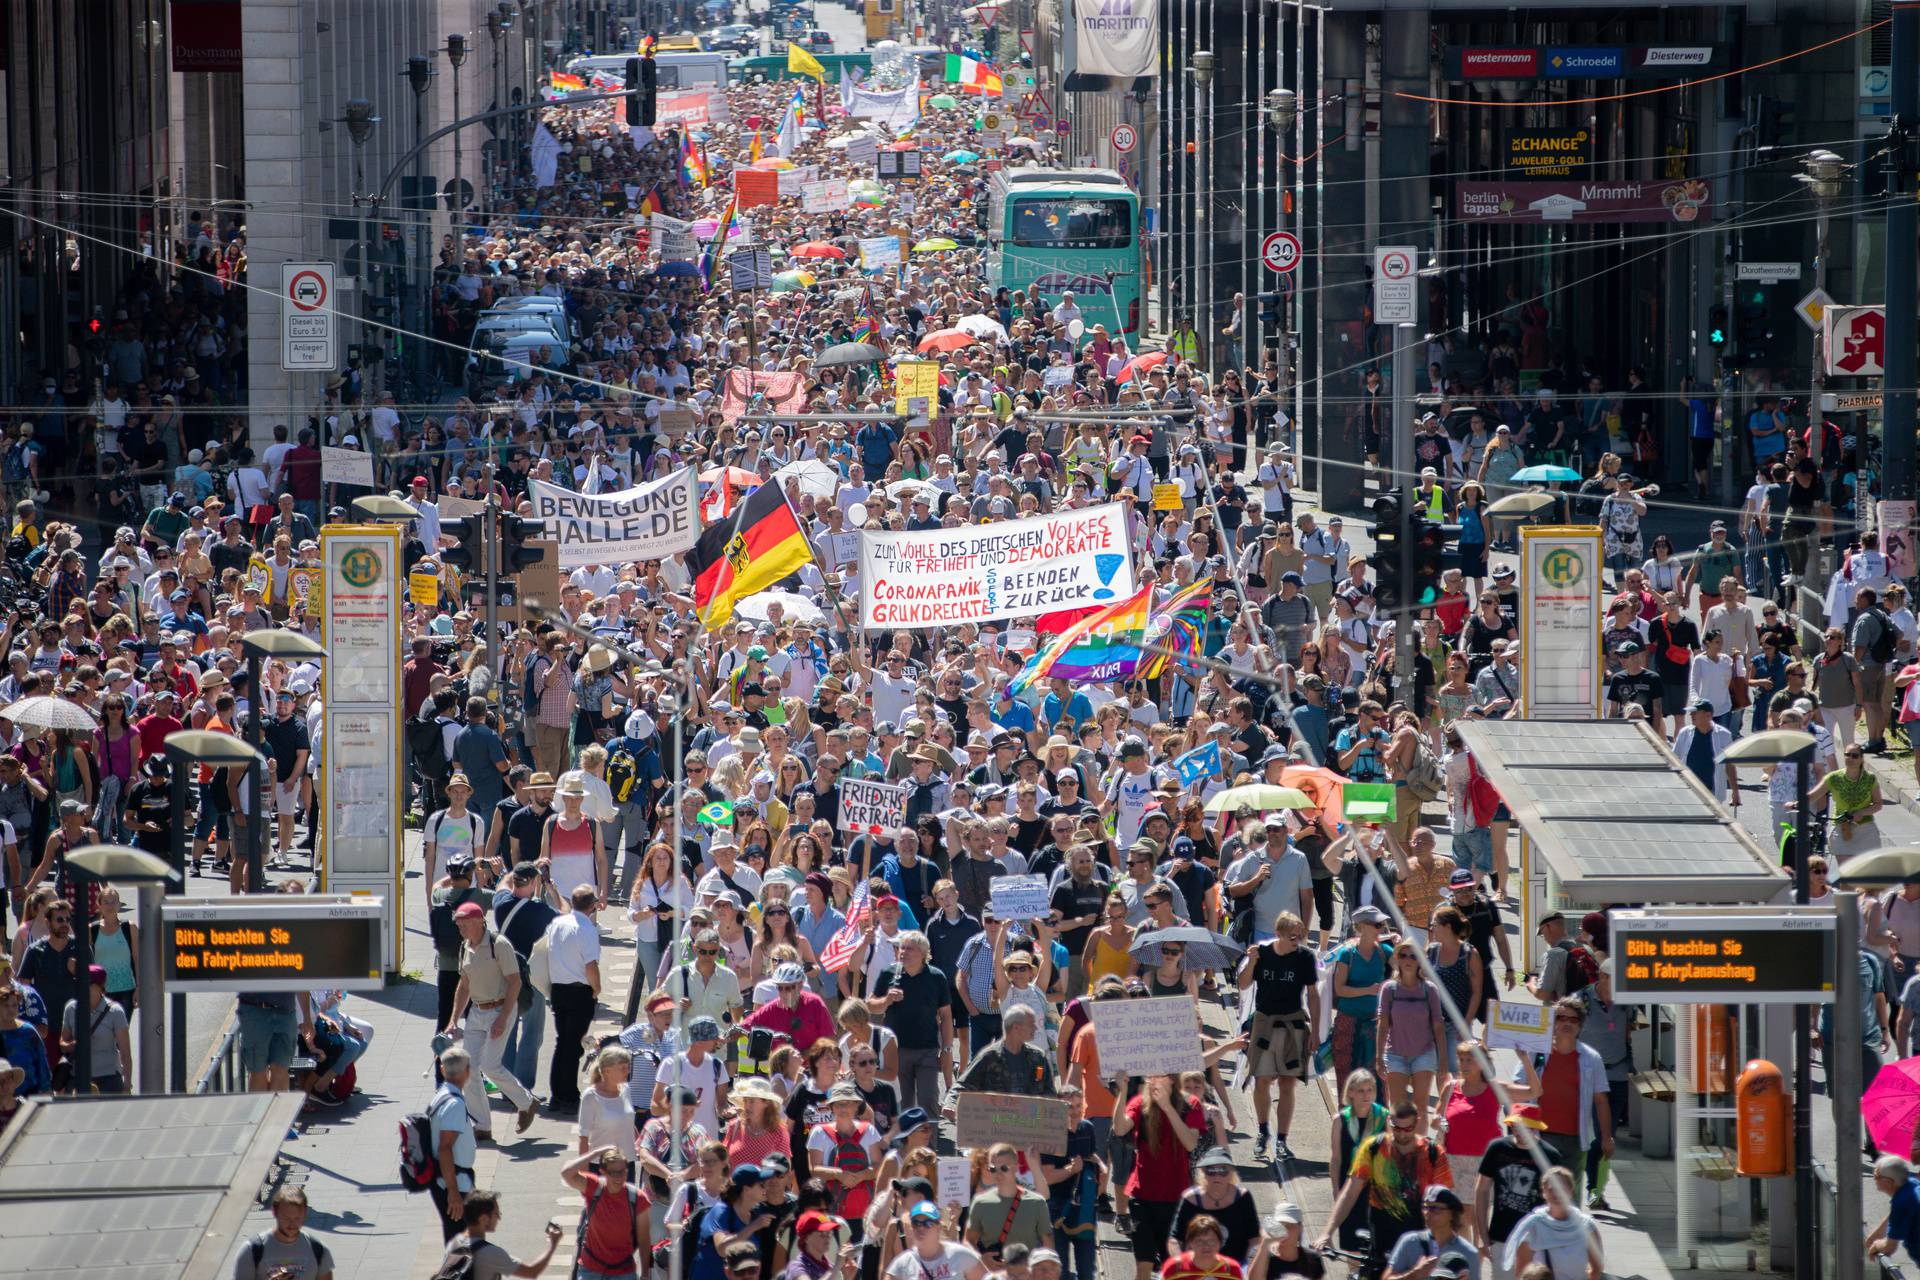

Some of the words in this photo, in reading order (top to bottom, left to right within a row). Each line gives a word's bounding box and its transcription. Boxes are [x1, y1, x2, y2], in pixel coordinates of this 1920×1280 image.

[1084, 16, 1148, 30] MARITIM
[175, 45, 241, 58] Dussmann
[1467, 53, 1532, 64] westermann
[1651, 51, 1704, 62] Diesterweg
[1566, 56, 1616, 67] Schroedel
[1116, 132, 1131, 145] 30
[1525, 166, 1570, 176] LEIHHAUS
[1463, 191, 1499, 203] berlin
[1581, 184, 1641, 199] Mmmh!
[1463, 203, 1499, 216] tapas
[1271, 243, 1293, 261] 30
[1741, 266, 1797, 275] Dorotheenstraße
[1034, 271, 1113, 296] AFAN
[291, 318, 313, 326] Diesel
[314, 318, 325, 326] bis
[293, 344, 323, 352] Anlieger
[302, 353, 315, 361] frei
[1838, 395, 1884, 408] PHARMAC
[540, 485, 688, 518] BEWEGUNG
[542, 507, 689, 545] HALLE.DE
[874, 543, 896, 559] ZUM
[895, 540, 937, 560] WOHLE
[940, 541, 968, 557] DES
[970, 529, 1044, 555] DEUTSCHEN
[1047, 515, 1109, 541] VOLKES
[916, 554, 977, 574] FREIHEIT
[980, 550, 1006, 567] UND
[1007, 531, 1112, 564] DEMOKRATIE
[1003, 566, 1080, 591] BEENDEN
[873, 599, 993, 623] GRUNDRECHTE
[1004, 584, 1091, 610] ZURÜCK
[842, 782, 905, 812] FRIEDENS
[842, 804, 902, 829] VERTRAG
[176, 911, 195, 919] Linie
[202, 911, 217, 919] Ziel
[329, 909, 359, 918] Abfahrt
[1654, 921, 1669, 929] Ziel
[1782, 920, 1812, 929] Abfahrt
[175, 928, 205, 946] Bitte
[210, 928, 265, 946] beachten
[270, 928, 290, 944] Sie
[1626, 939, 1657, 956] Bitte
[1661, 939, 1718, 956] beachten
[1723, 939, 1743, 955] Sie
[176, 953, 198, 968] den
[203, 951, 304, 971] Fahrplanaushang
[1627, 963, 1649, 979] den
[1653, 962, 1756, 982] Fahrplanaushang
[1501, 1009, 1530, 1025] WIR
